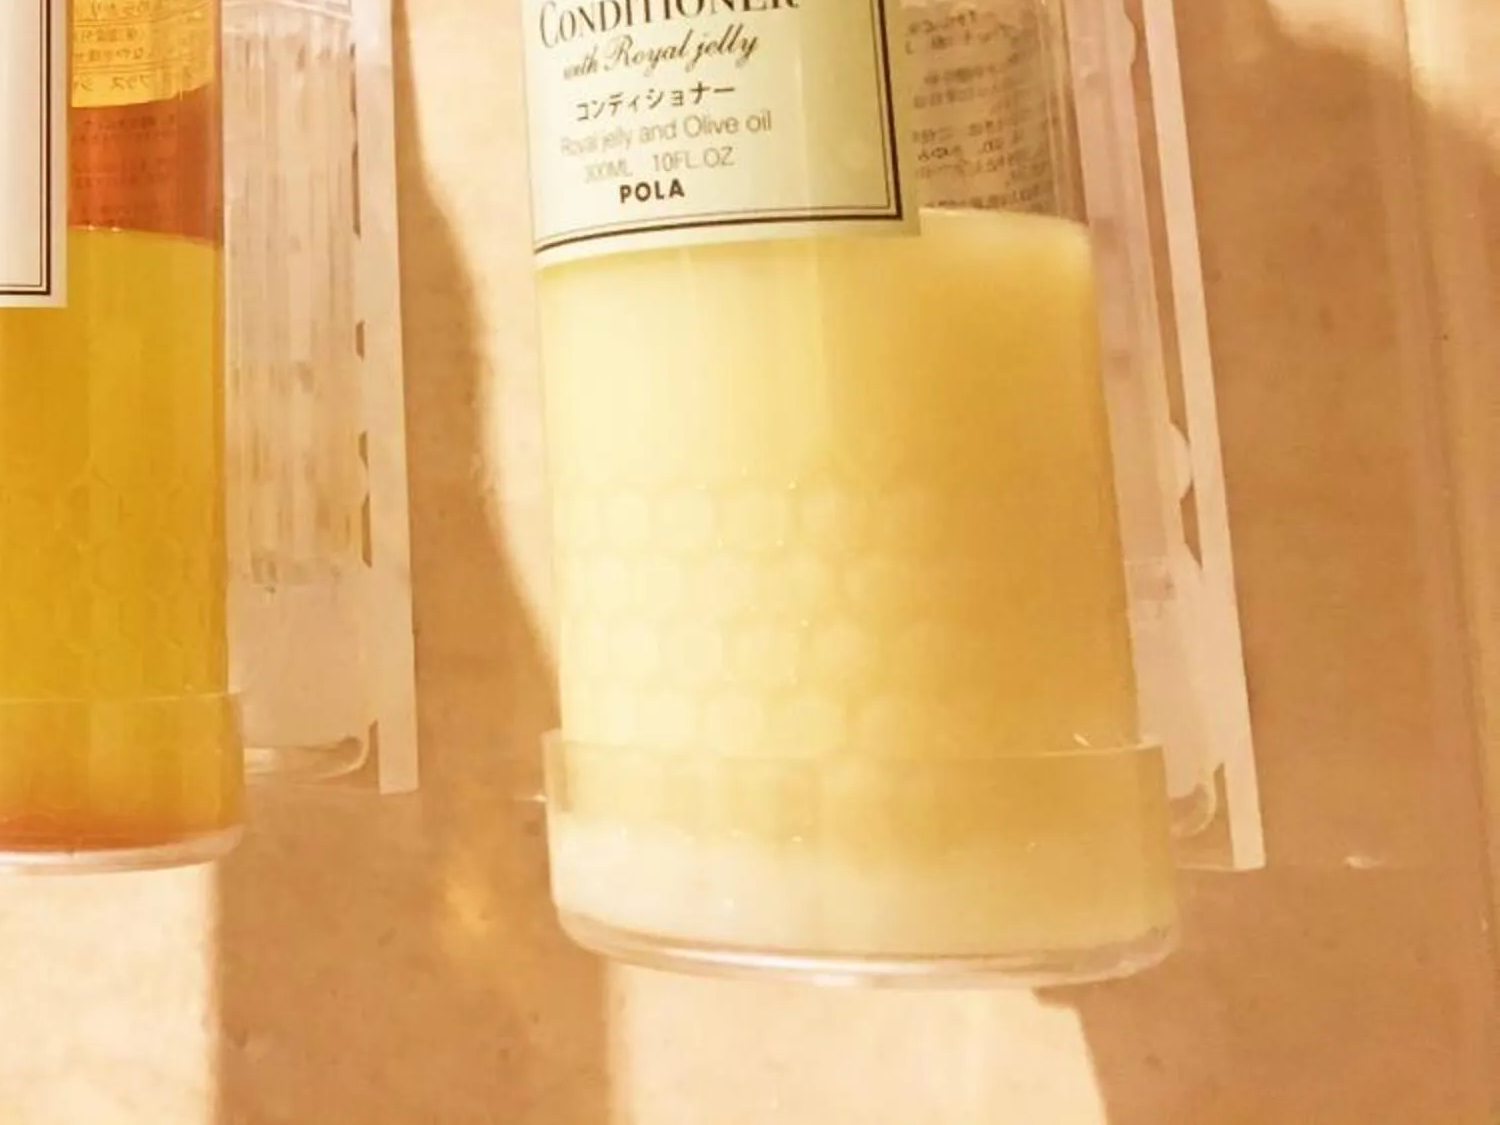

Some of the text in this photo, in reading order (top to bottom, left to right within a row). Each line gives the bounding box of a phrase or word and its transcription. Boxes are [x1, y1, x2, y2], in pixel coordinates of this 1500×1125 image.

[604, 28, 693, 77] Royal
[685, 23, 758, 73] jelly
[577, 81, 735, 121] コンディショナー
[639, 119, 677, 143] and
[683, 115, 739, 138] Olive
[746, 110, 772, 132] oil
[619, 178, 685, 203] POLA
